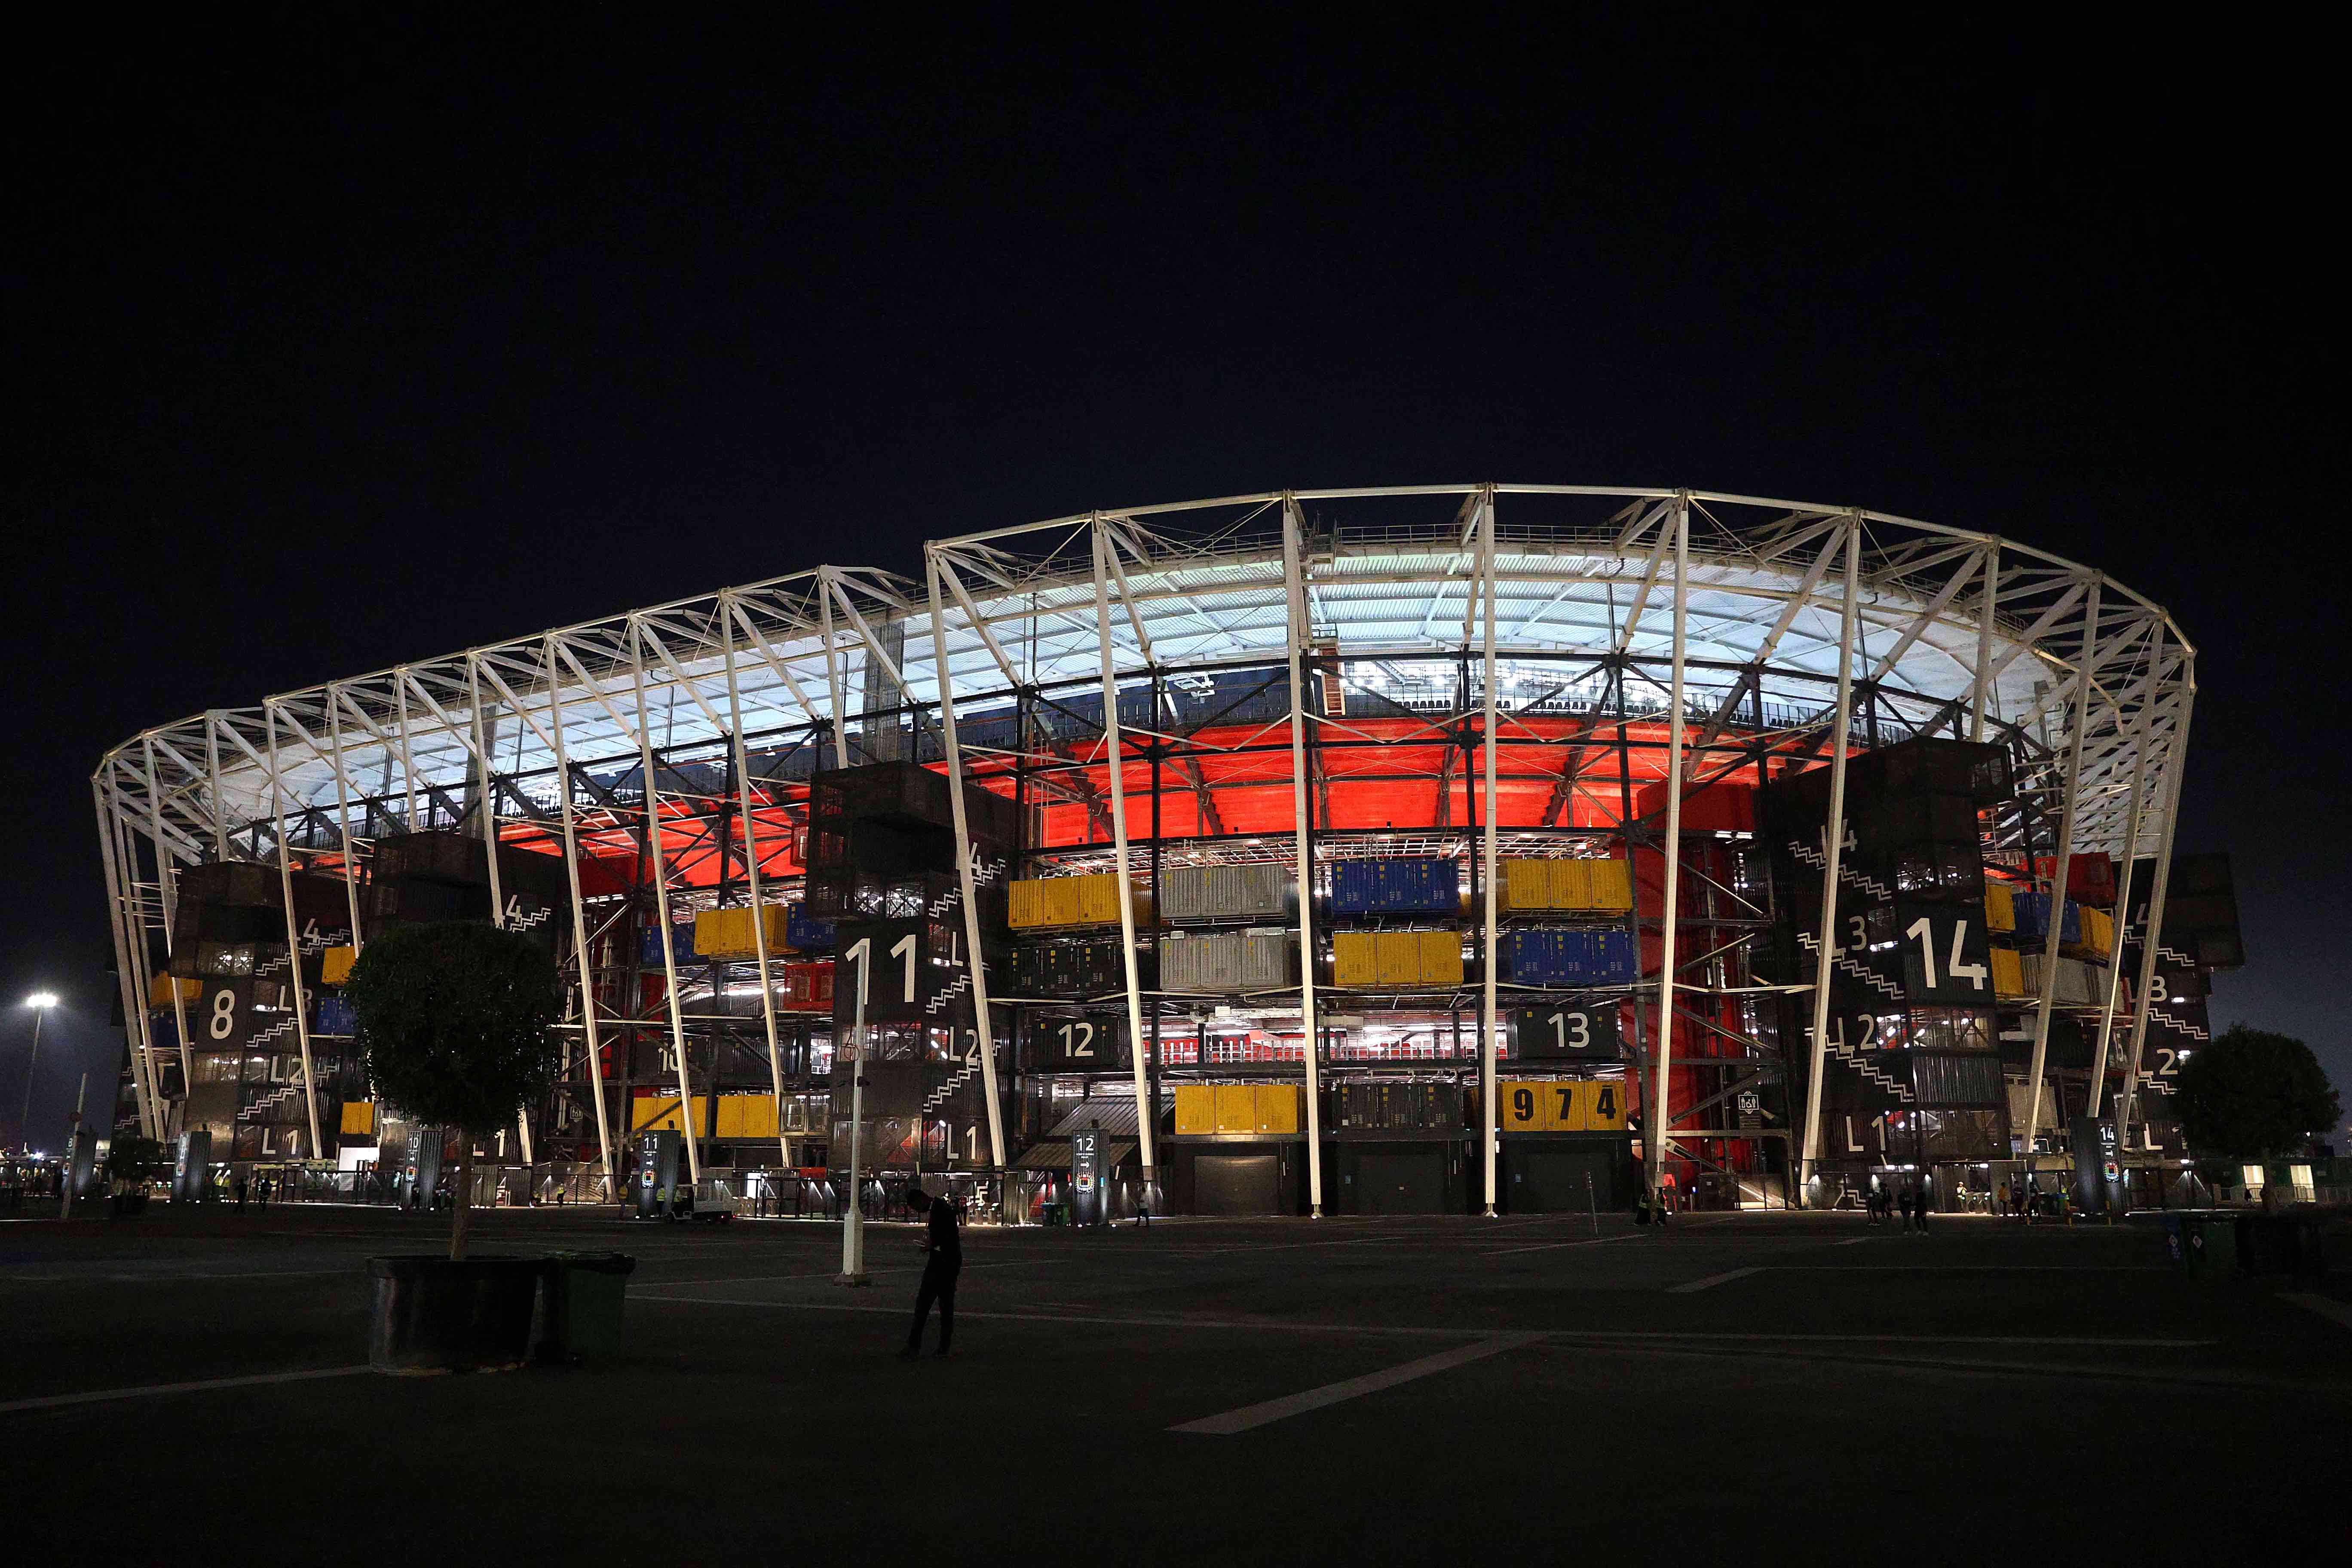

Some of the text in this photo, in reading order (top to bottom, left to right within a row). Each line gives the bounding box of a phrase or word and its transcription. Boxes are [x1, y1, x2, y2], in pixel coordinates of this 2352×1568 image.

[956, 842, 983, 876] 4
[493, 894, 522, 922] 4
[288, 918, 320, 943] 4
[845, 934, 916, 1005] 11
[1906, 917, 1988, 990] 14
[210, 989, 235, 1039] 8
[1547, 1012, 1590, 1047] 13
[949, 1026, 978, 1063] L2
[1058, 1023, 1093, 1057] 12
[1838, 1014, 1877, 1054] L2
[270, 1056, 306, 1084] L2
[2138, 1048, 2178, 1075] L2
[262, 1128, 298, 1155] L1
[409, 1137, 418, 1148] 10
[644, 1137, 657, 1149] 11
[947, 1124, 977, 1159] L1
[1076, 1138, 1094, 1151] 12
[1846, 1116, 1886, 1152] L1
[2100, 1127, 2114, 1140] 14
